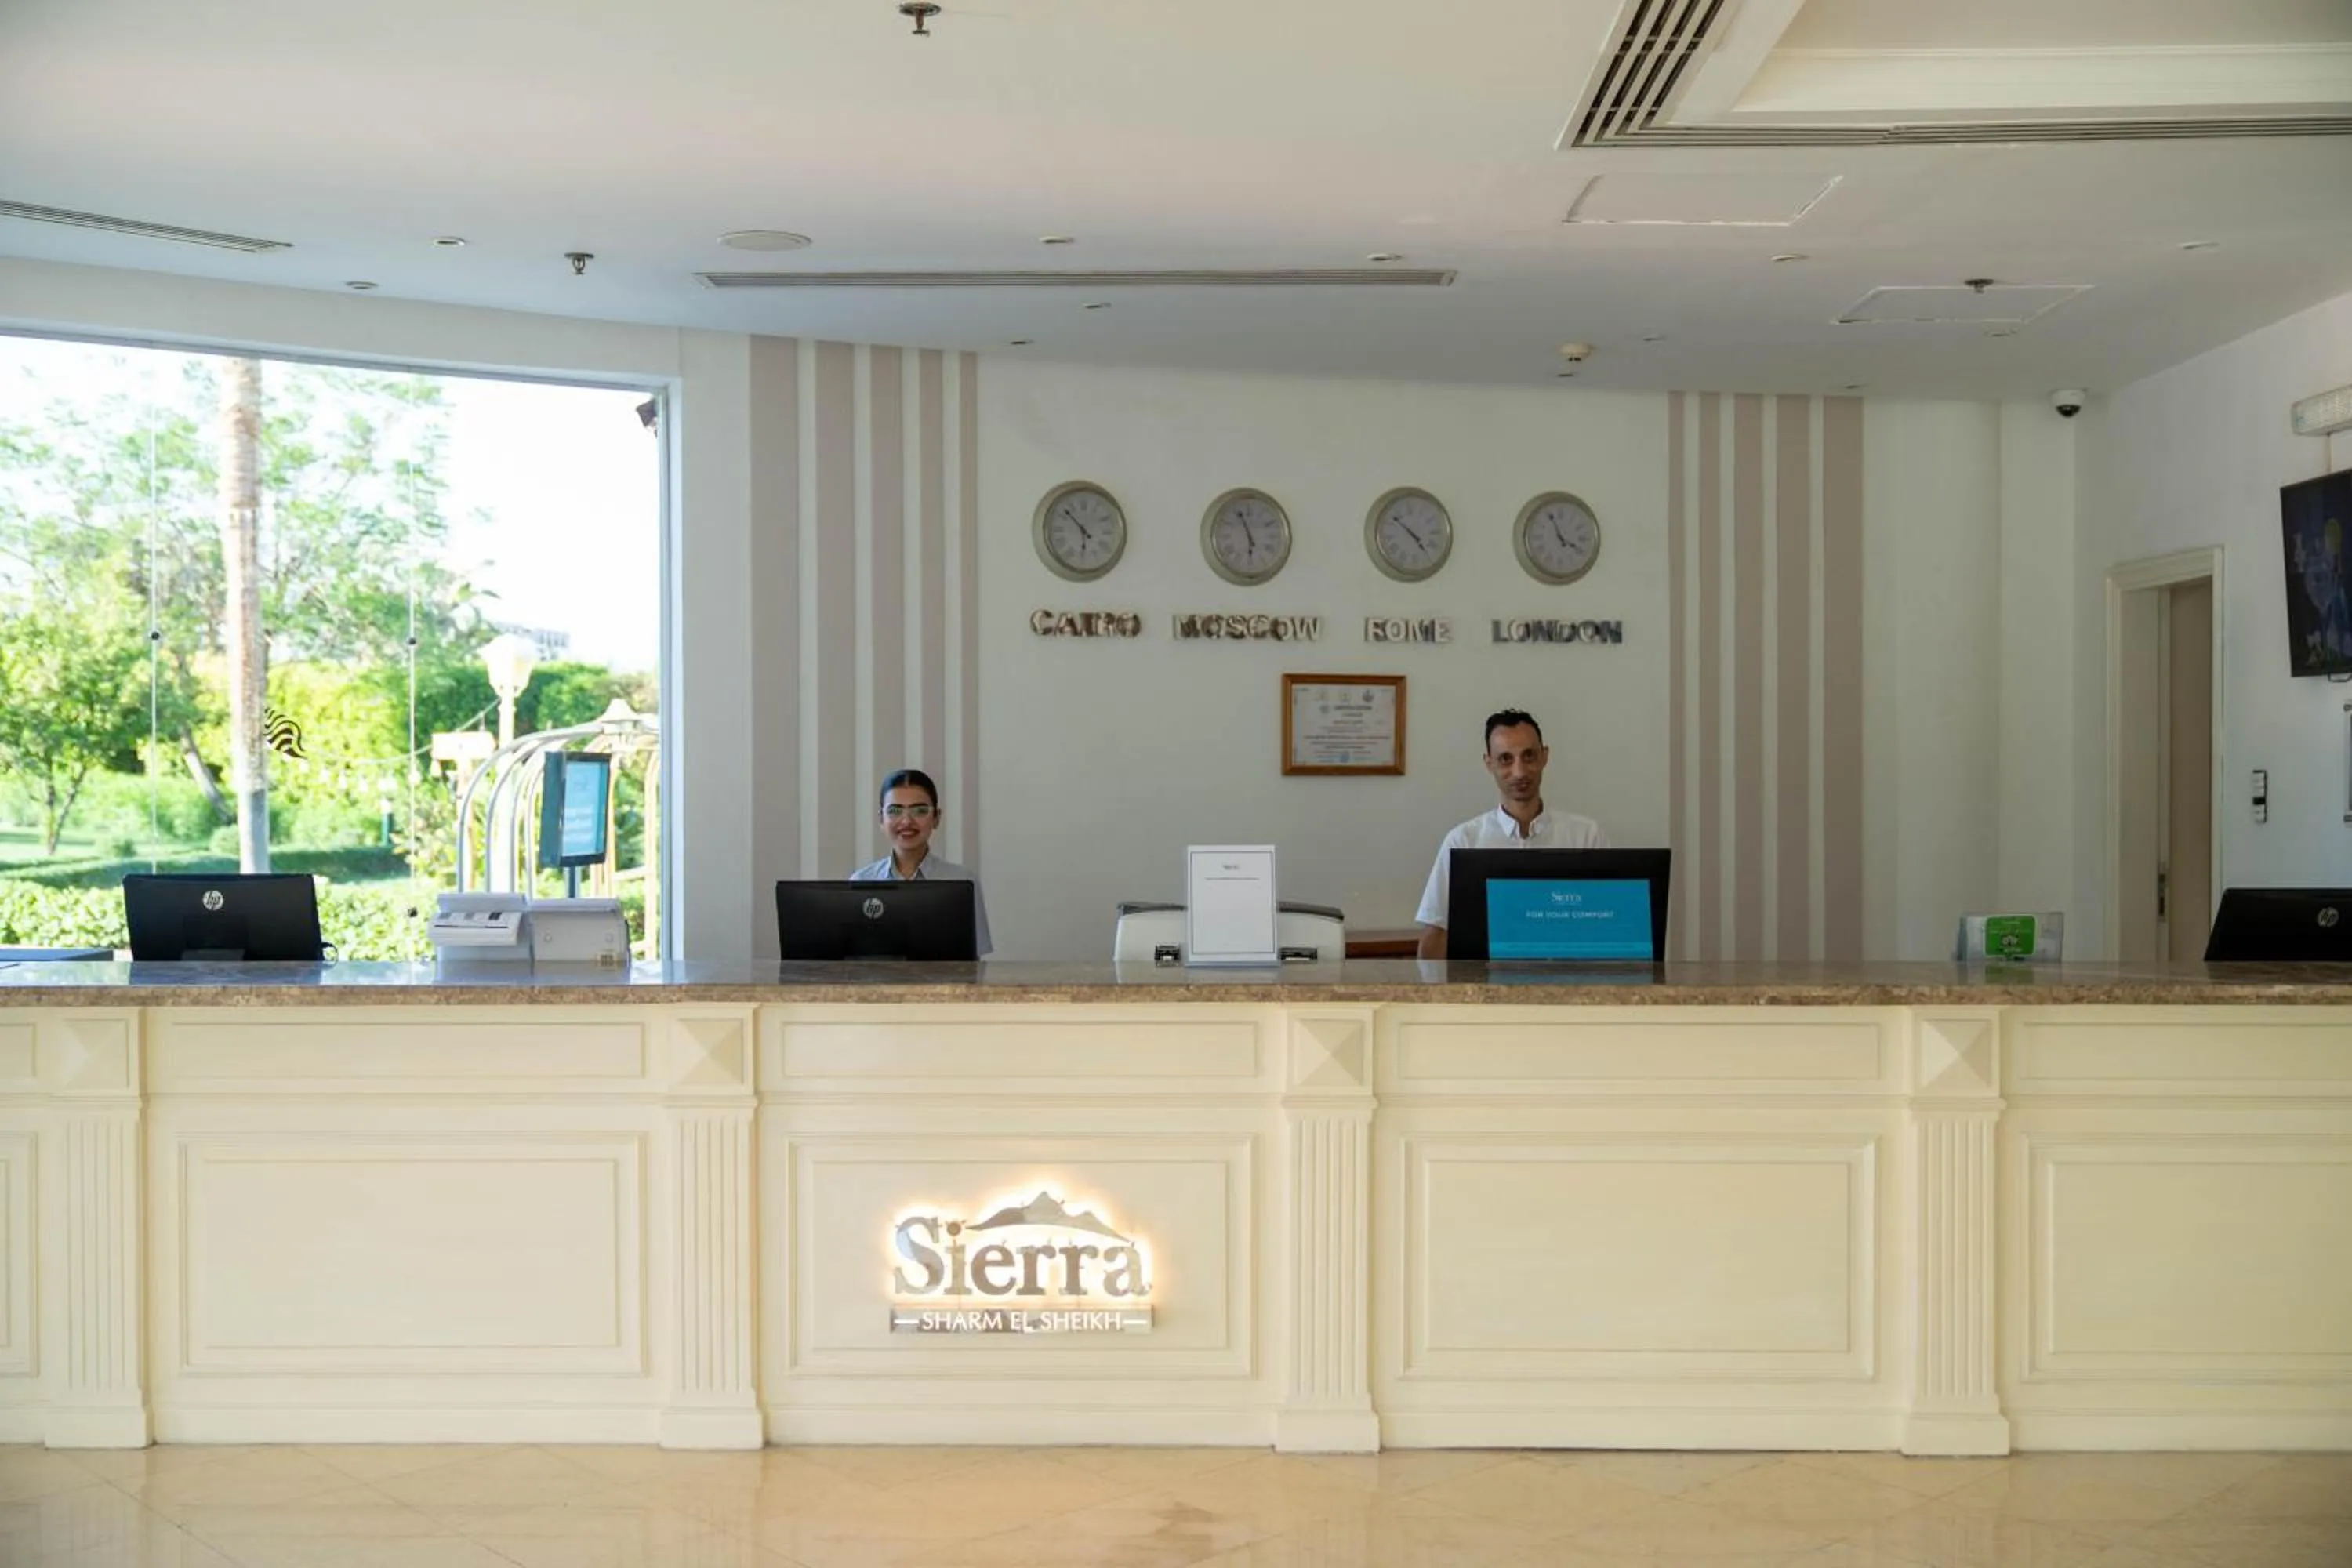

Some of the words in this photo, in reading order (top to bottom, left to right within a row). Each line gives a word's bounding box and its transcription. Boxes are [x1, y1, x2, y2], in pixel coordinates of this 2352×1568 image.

[1030, 609, 1142, 637] CAIRO
[1173, 614, 1323, 641] MOSCOW
[1364, 617, 1451, 643] ROME
[1492, 620, 1624, 643] LONDON
[202, 890, 224, 911] hp
[862, 898, 884, 919] hp
[894, 1216, 1152, 1296] Sierra
[922, 1312, 1003, 1331] SHARM
[1011, 1312, 1033, 1331] EL
[1040, 1312, 1121, 1331] SHEIKH
